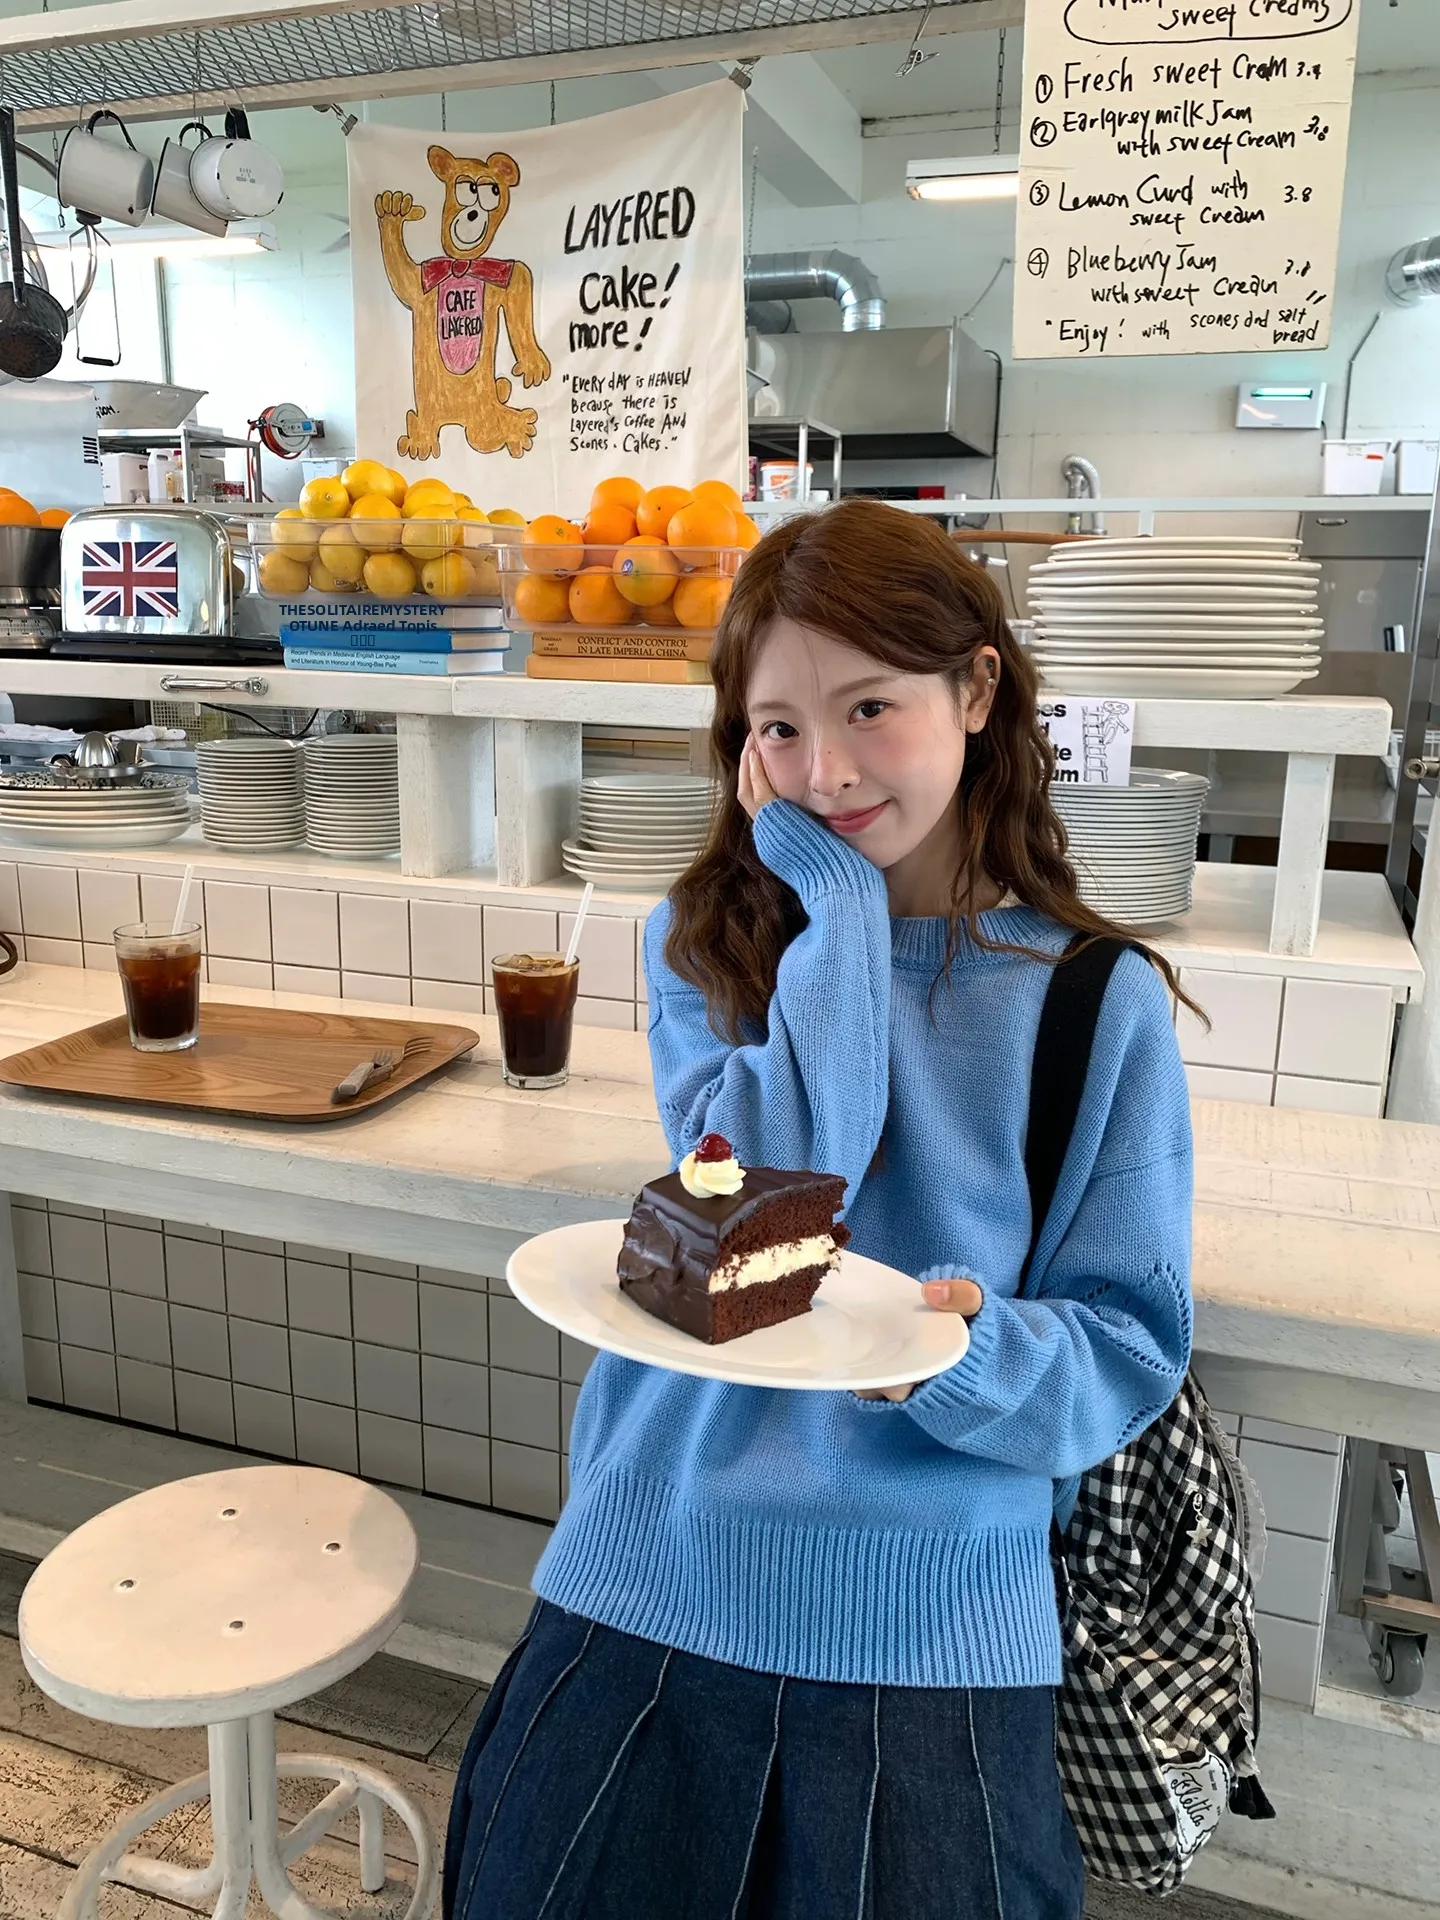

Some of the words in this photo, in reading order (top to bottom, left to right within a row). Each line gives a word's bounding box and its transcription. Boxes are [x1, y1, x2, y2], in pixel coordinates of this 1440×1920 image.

[1158, 4, 1236, 37] sweet
[1064, 57, 1133, 99] Fresh
[1152, 58, 1222, 89] sweet
[1117, 129, 1161, 159] with
[1167, 133, 1234, 164] sweet
[1058, 181, 1130, 211] Lemon
[1136, 174, 1194, 204] Curd
[1211, 169, 1249, 200] with
[1283, 185, 1313, 203] 3.8
[564, 186, 696, 255] LAYERED
[1130, 212, 1185, 234] sweet
[1068, 245, 1171, 287] Blueberry
[1176, 243, 1217, 273] Jam
[579, 262, 681, 315] Cake!
[1091, 282, 1129, 302] with
[1134, 283, 1200, 307] sweet
[446, 290, 477, 313] CAFE
[441, 316, 484, 340] LAYERED
[1142, 319, 1170, 340] with
[1244, 310, 1269, 328] and
[1278, 307, 1308, 324] salt
[1273, 319, 1320, 344] bread
[636, 376, 645, 388] is
[648, 367, 691, 388] HEAVEN
[571, 398, 613, 415] Because
[622, 394, 656, 410] there
[663, 395, 678, 410] is
[570, 416, 620, 435] Layered's
[577, 636, 621, 646] CONFLICT
[623, 637, 644, 647] AND
[644, 638, 689, 648] CONTROL
[590, 646, 611, 655] LATE
[613, 648, 653, 657] IMPERIAL
[655, 649, 687, 658] CHINA
[375, 653, 400, 661] Language
